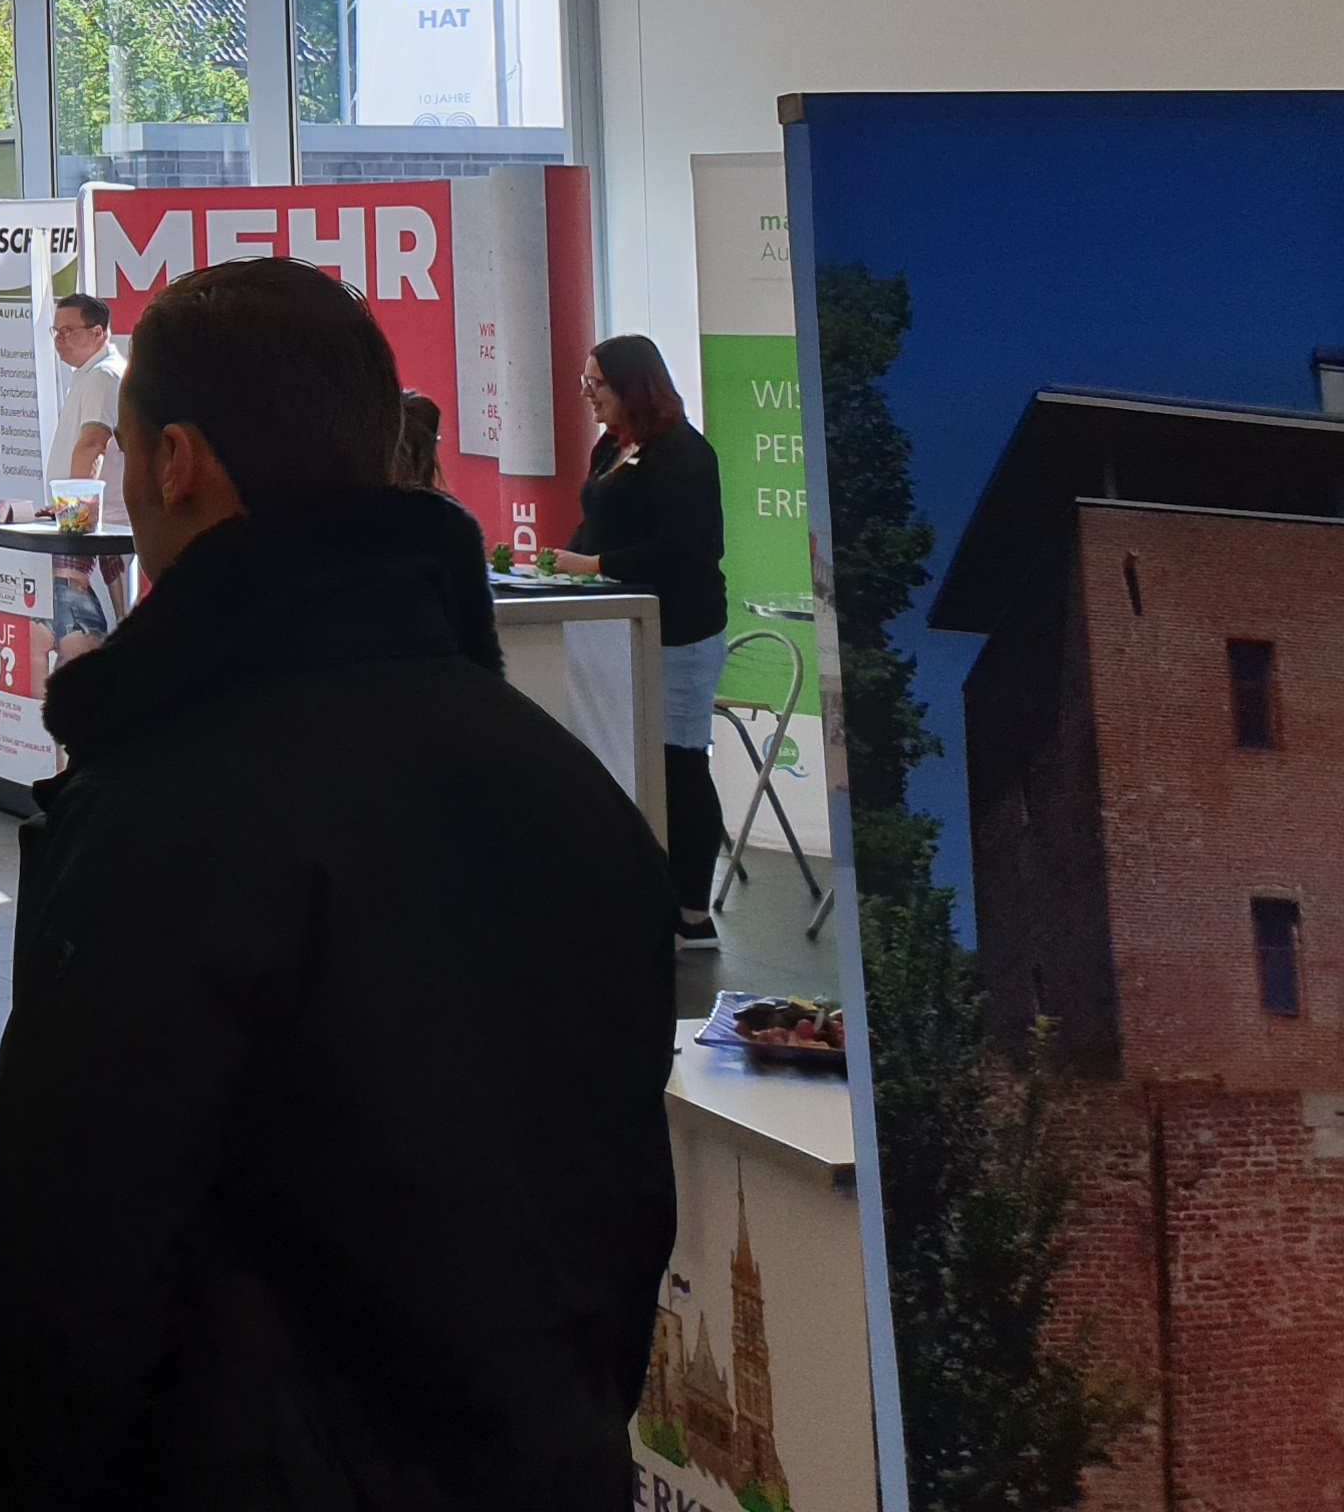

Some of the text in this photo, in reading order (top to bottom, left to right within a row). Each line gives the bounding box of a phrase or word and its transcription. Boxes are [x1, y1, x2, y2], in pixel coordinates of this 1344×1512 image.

[419, 8, 470, 29] HAT
[418, 92, 471, 105] 10 JAHRE
[95, 205, 440, 301] MEHR
